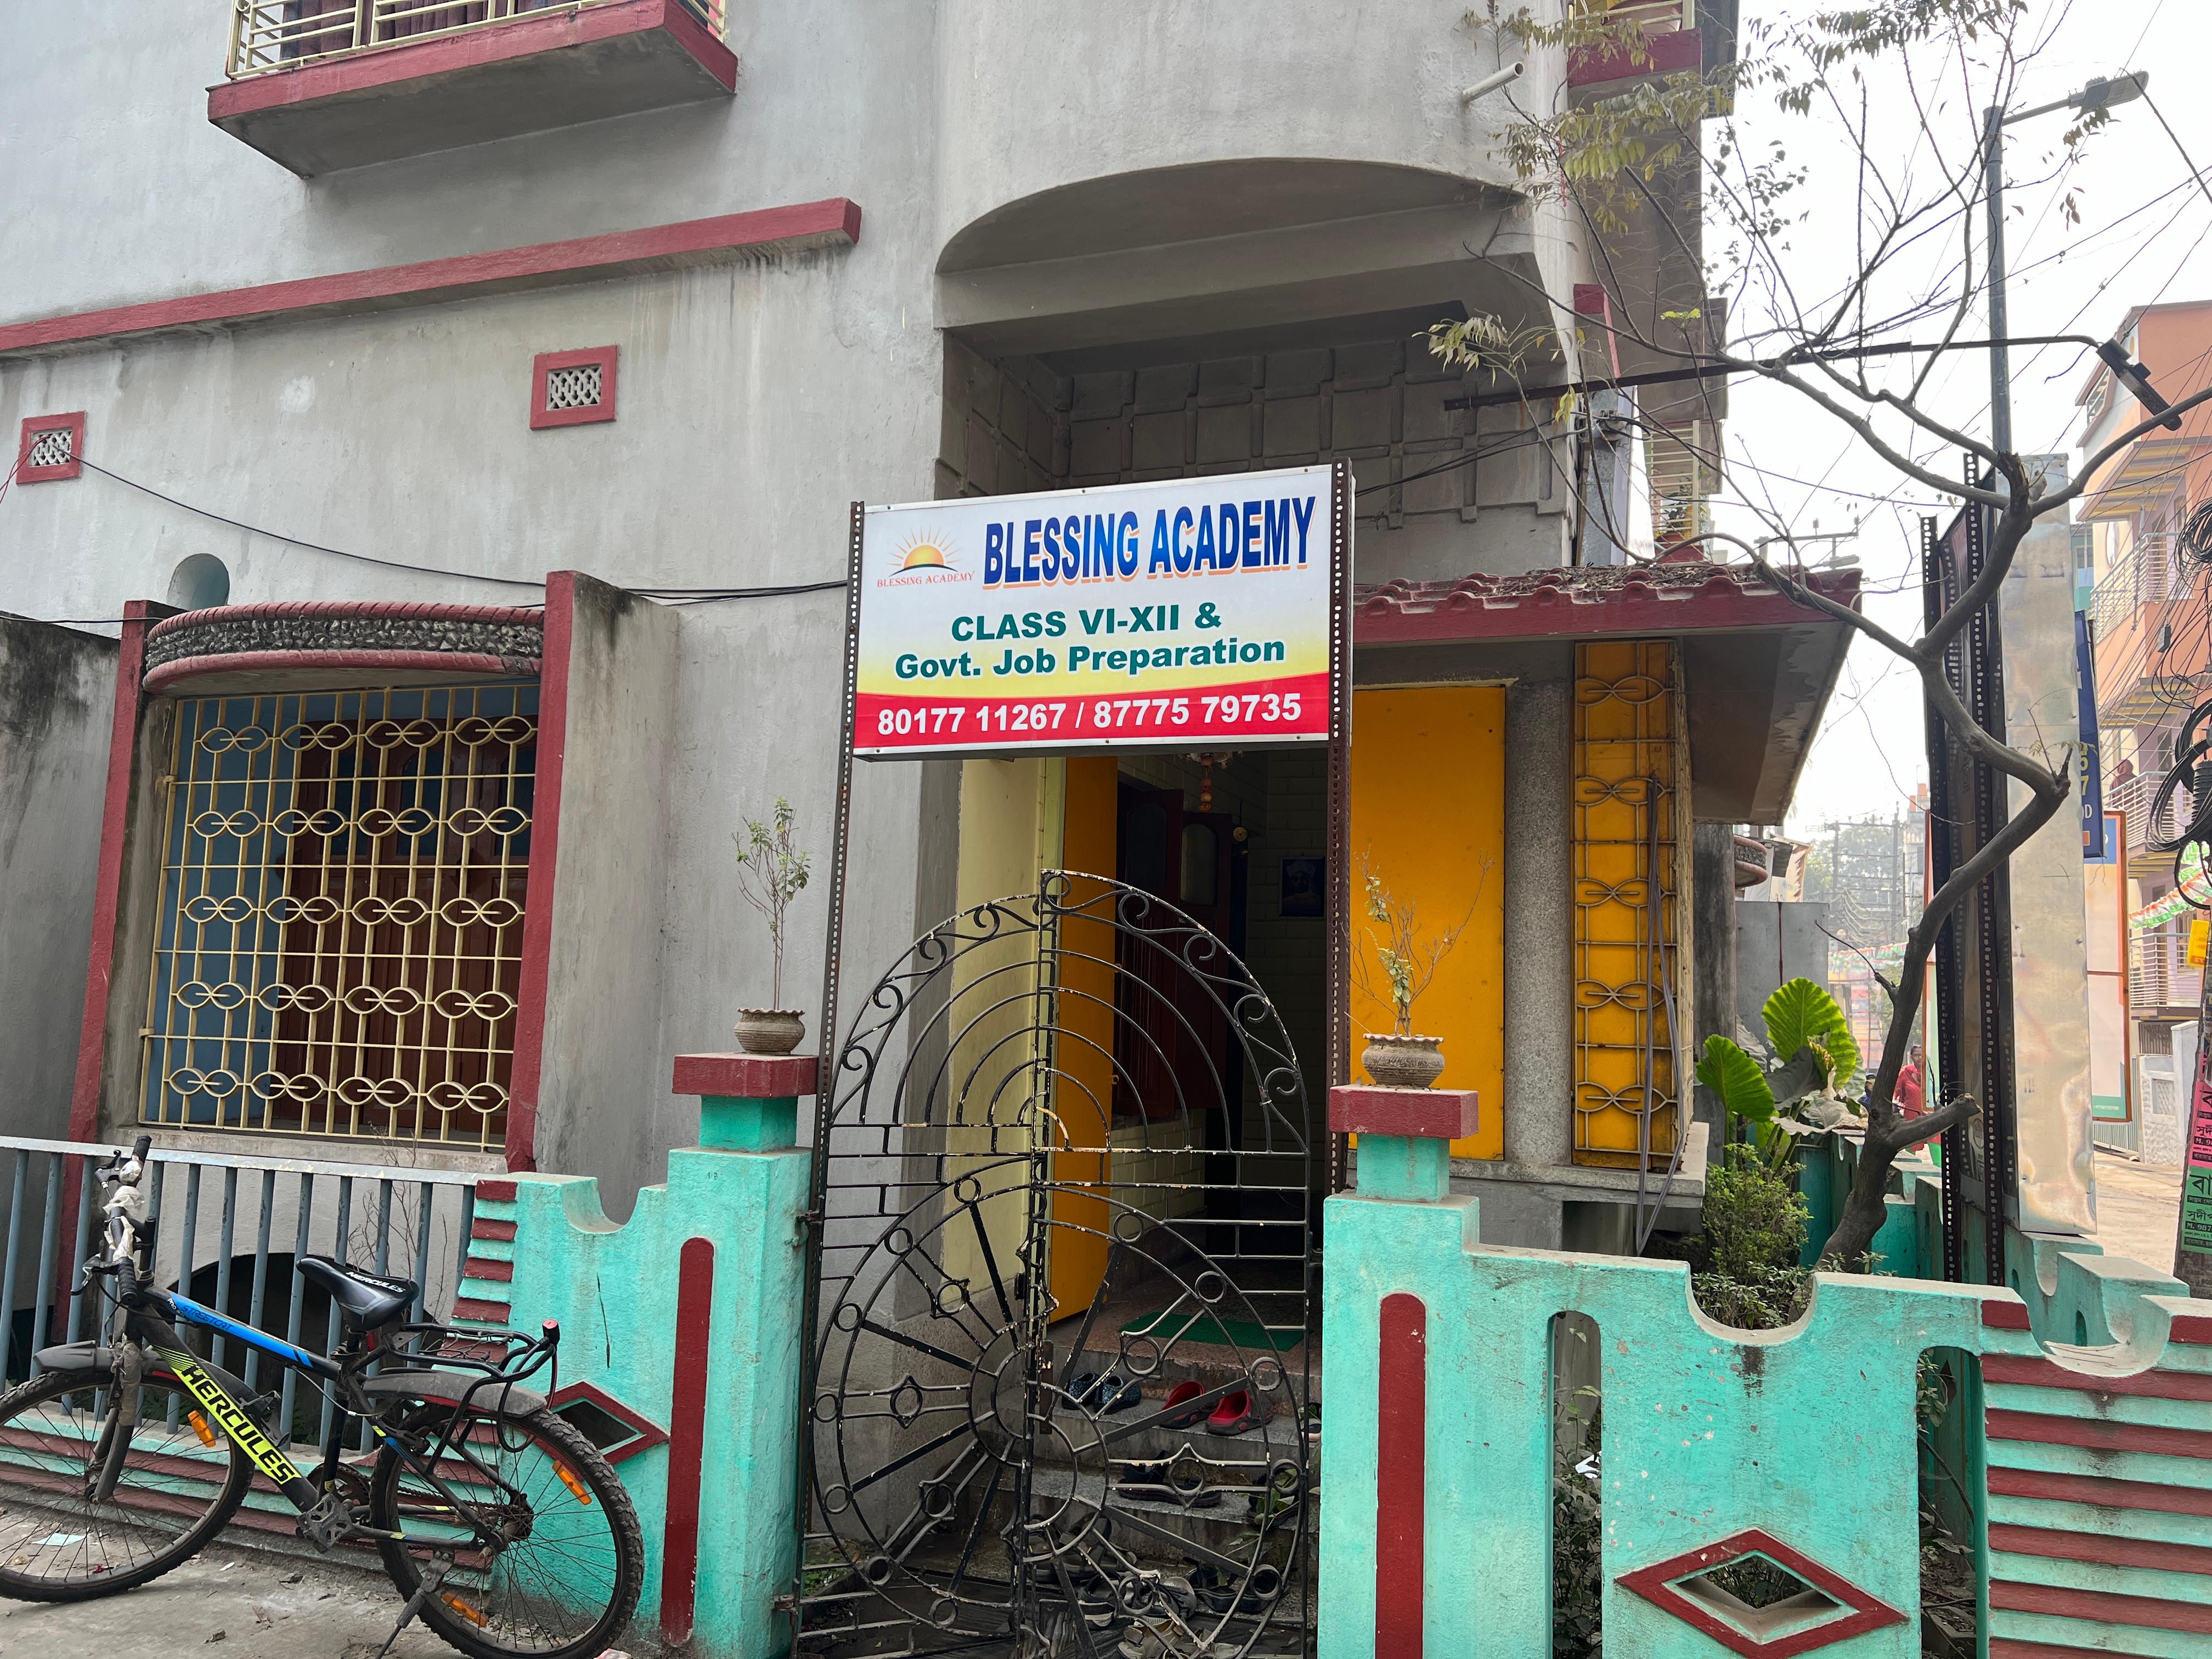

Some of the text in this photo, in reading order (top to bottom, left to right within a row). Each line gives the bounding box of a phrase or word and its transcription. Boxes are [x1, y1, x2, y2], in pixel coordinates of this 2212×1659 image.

[983, 496, 1316, 589] BLESSING ACADEMY
[878, 571, 975, 588] BLESSING ACADEMY
[952, 602, 1222, 641] CLASS VI-XII &
[896, 637, 1284, 679] Govt. Job Preparation
[878, 693, 1301, 735] 80177 11267 / 87775 79735
[346, 1272, 406, 1293] HERCULES
[182, 1305, 234, 1331] STREETCAT
[182, 1365, 295, 1482] HERCULES
